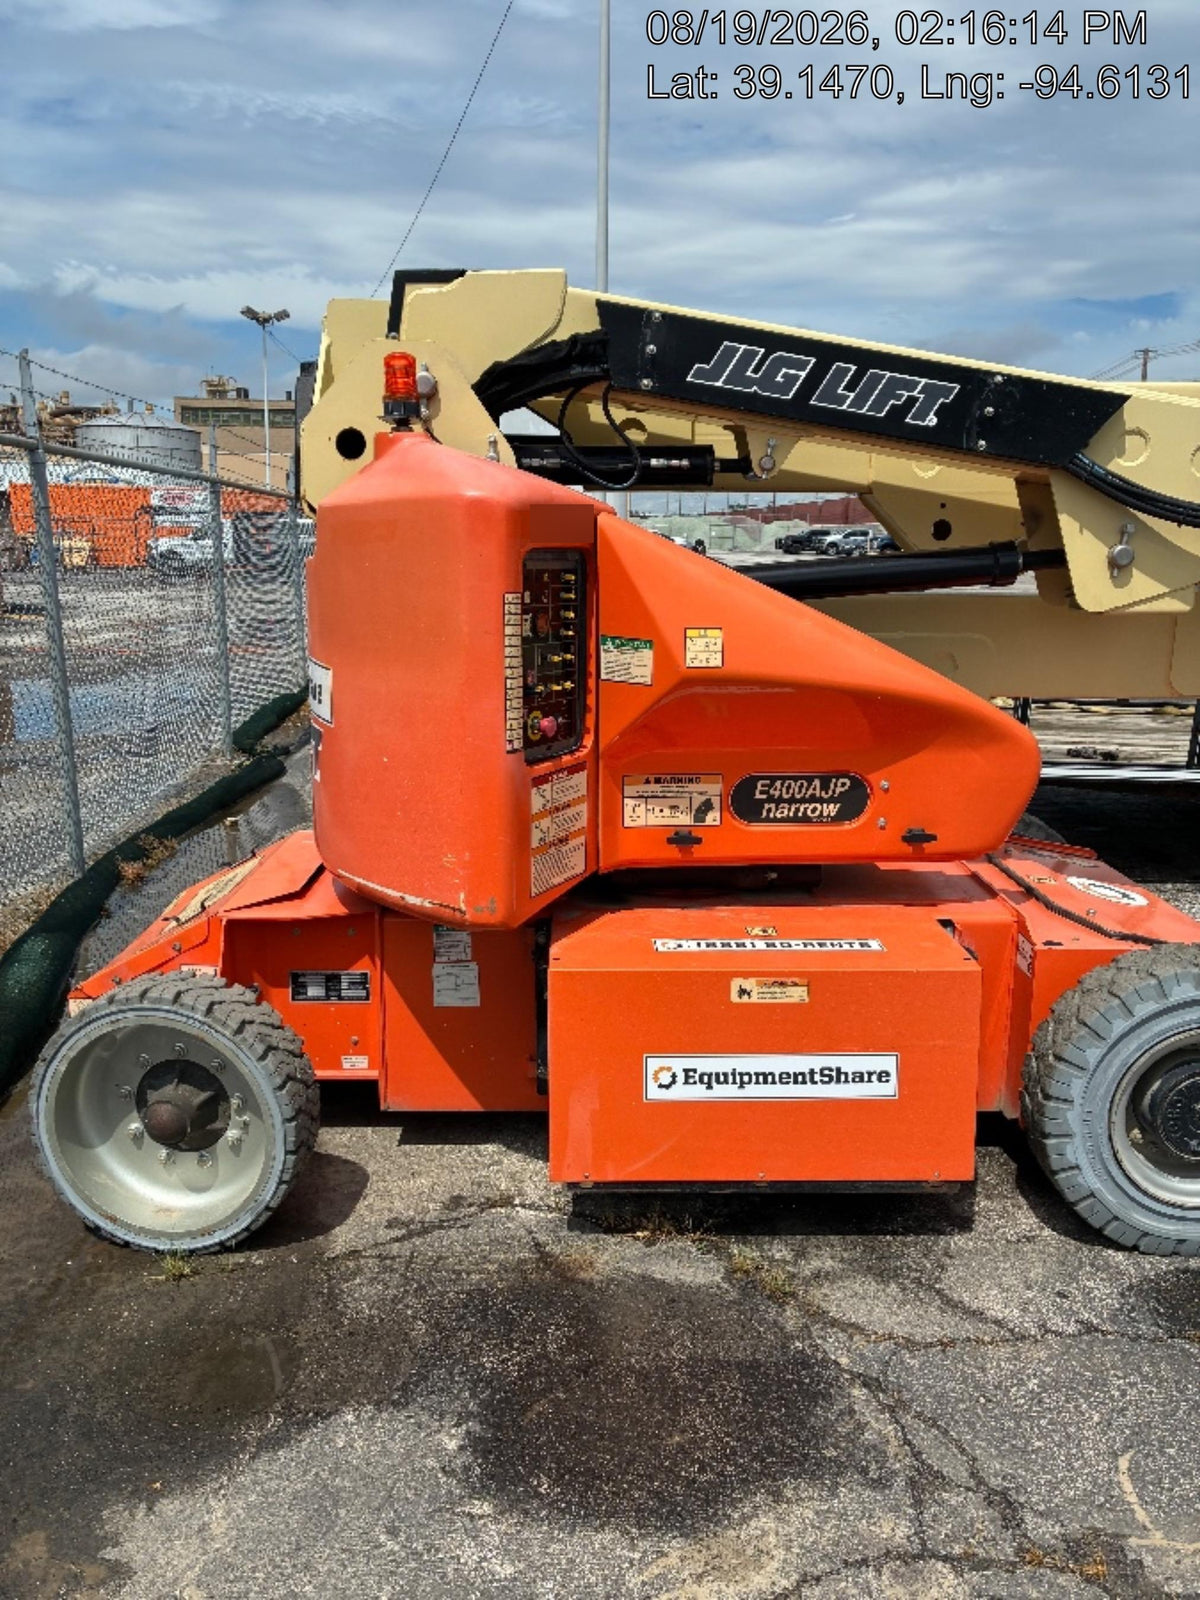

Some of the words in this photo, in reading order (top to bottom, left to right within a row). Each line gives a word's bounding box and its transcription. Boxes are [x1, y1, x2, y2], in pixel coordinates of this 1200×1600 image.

[686, 341, 816, 399] JLG
[809, 362, 960, 425] LIFT
[754, 778, 851, 799] E400AJP
[761, 802, 841, 819] narrow
[682, 1066, 892, 1090] EquipmentShare
